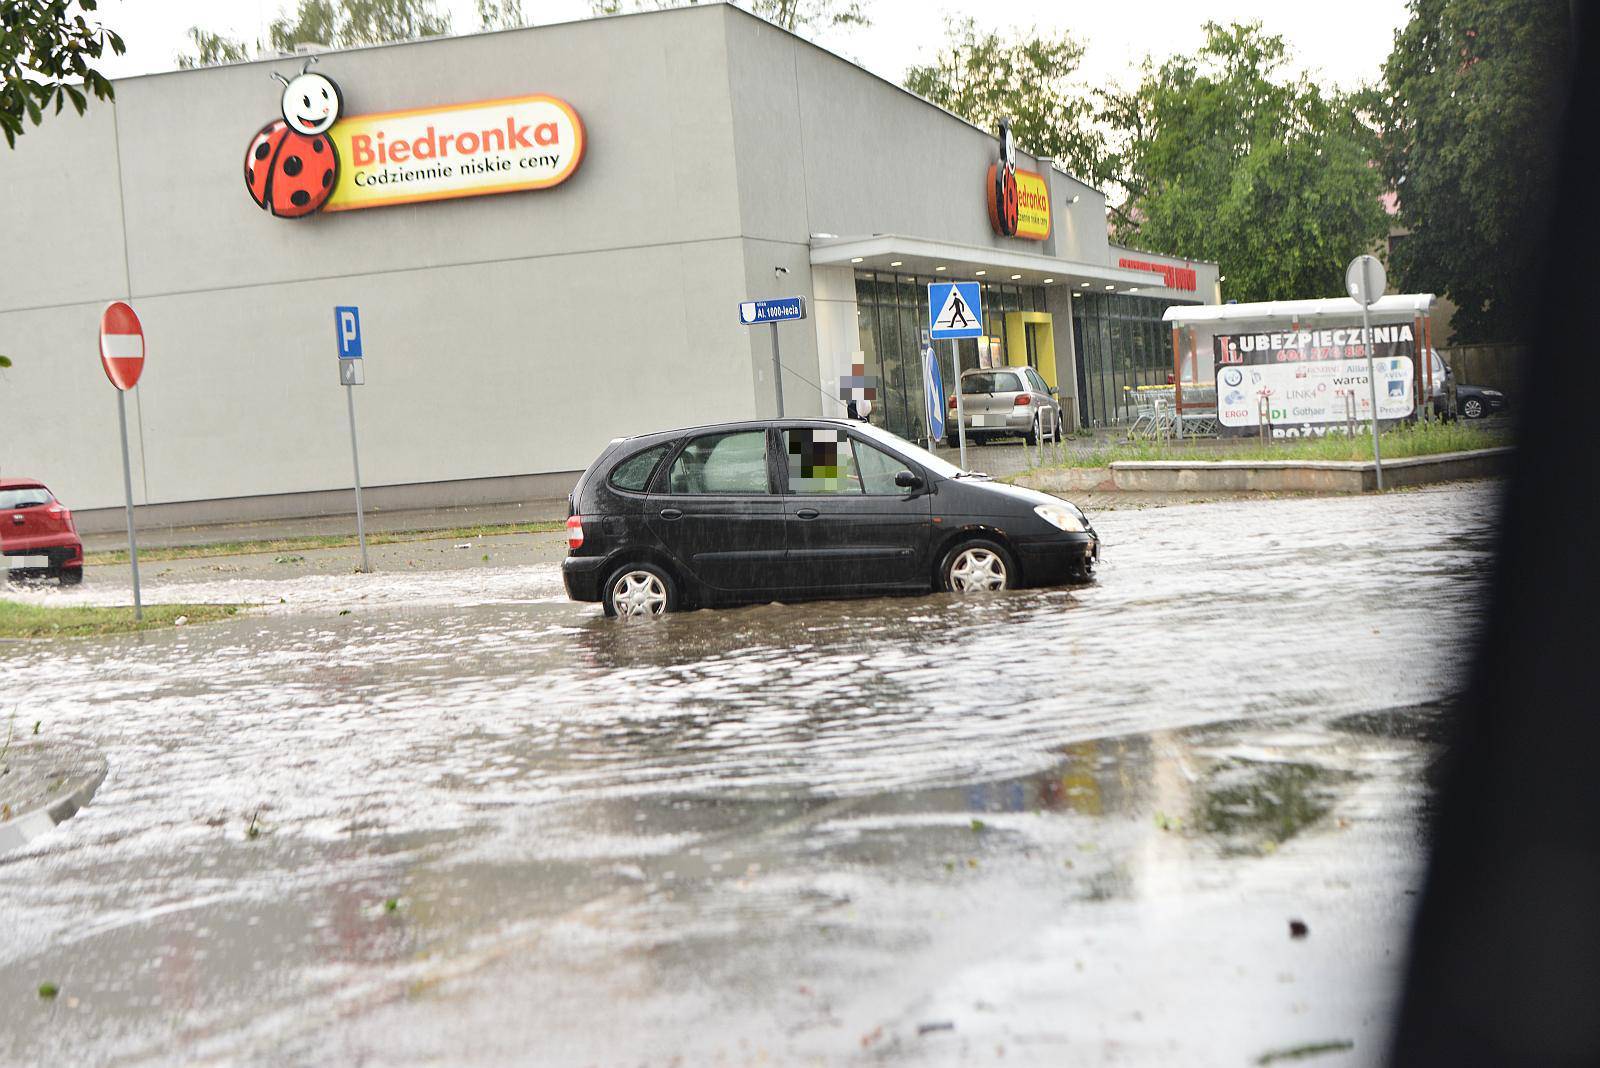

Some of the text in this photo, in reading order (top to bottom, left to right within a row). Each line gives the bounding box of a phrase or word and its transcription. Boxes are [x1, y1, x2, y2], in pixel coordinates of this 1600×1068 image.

[351, 117, 559, 167] Biedronka
[354, 152, 560, 187] Codziennie niskie ceny
[1018, 184, 1046, 212] edronka
[757, 304, 799, 318] Al. 1000-lecia
[341, 311, 357, 352] P
[1239, 325, 1414, 352] UBEZPIECZENIA
[1333, 376, 1369, 385] warta
[1225, 409, 1249, 418] ERGO
